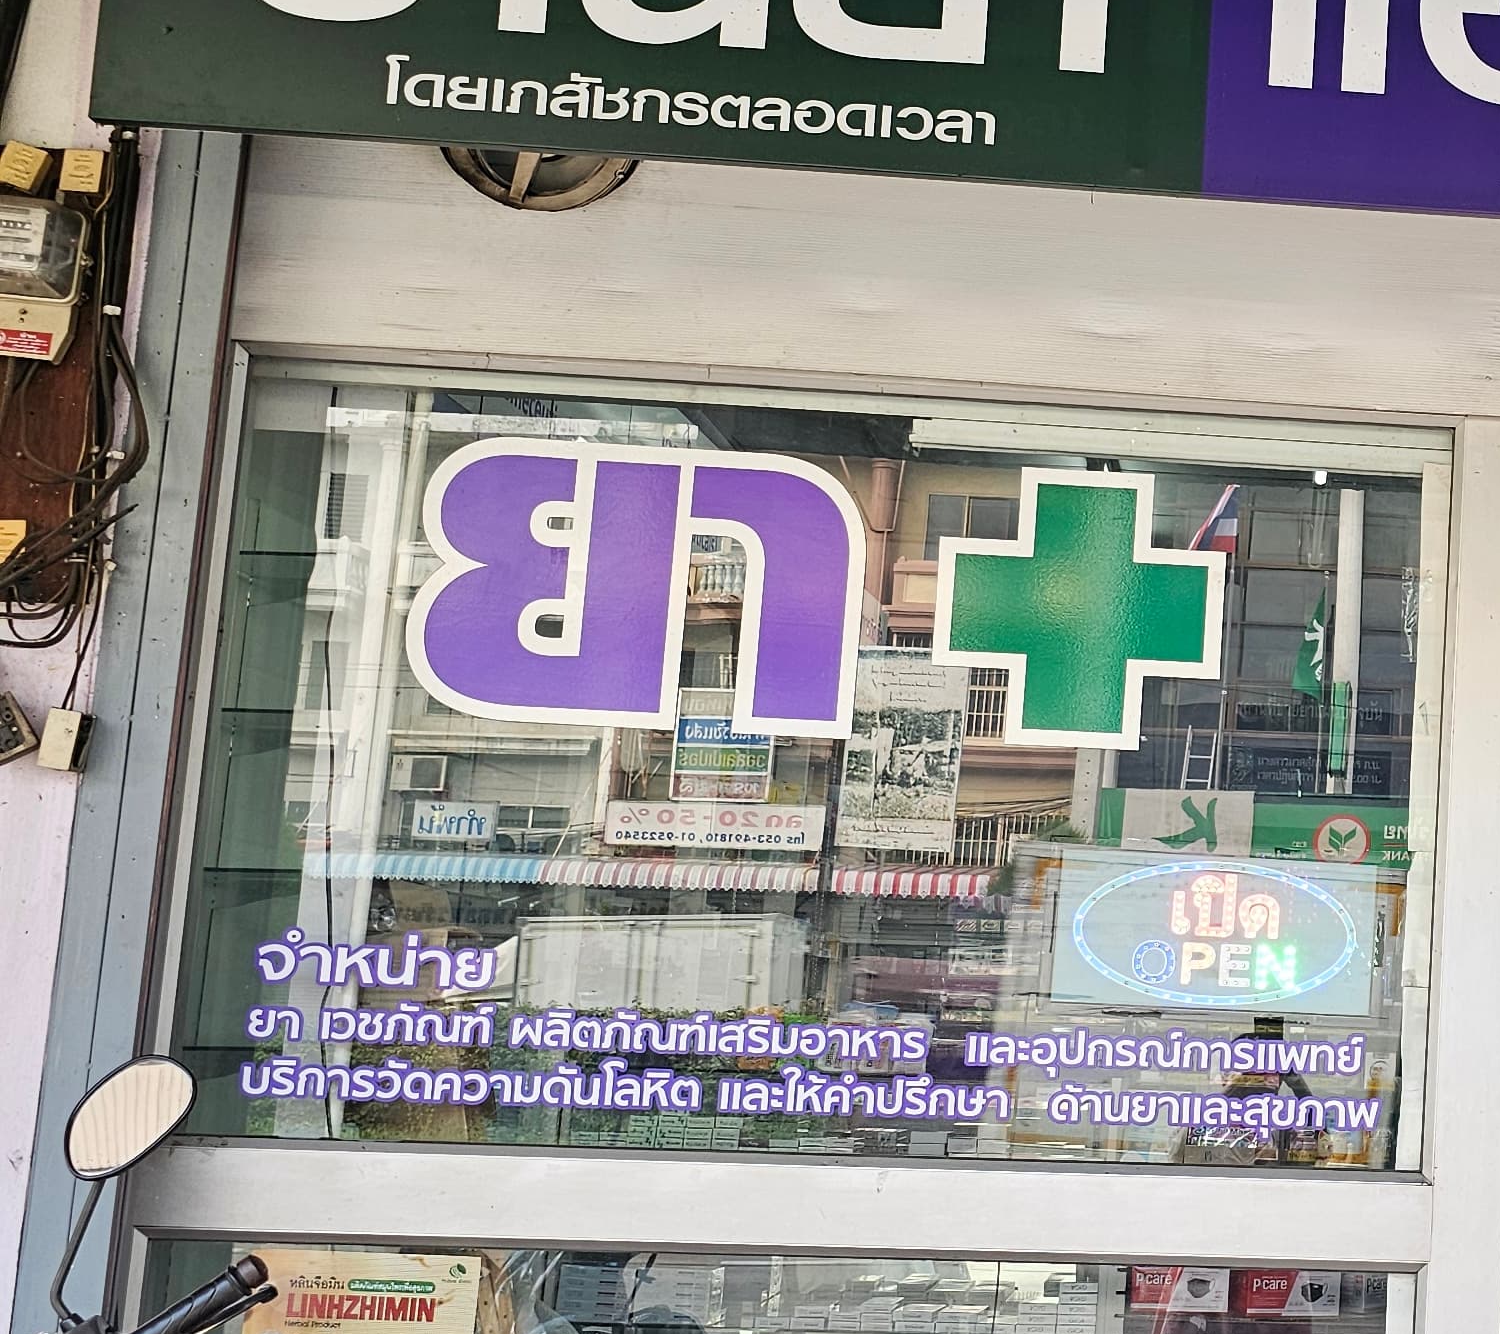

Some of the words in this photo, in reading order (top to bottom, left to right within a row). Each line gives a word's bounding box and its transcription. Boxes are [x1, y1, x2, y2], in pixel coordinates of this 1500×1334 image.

[385, 53, 997, 147] โดยเภสัชกรตลอดเวลา
[405, 436, 867, 739] ยา
[1169, 871, 1282, 941] เปิด
[256, 928, 496, 989] จำหน่าย
[1131, 938, 1299, 992] OPEN
[247, 1007, 301, 1040] ยา
[319, 1003, 496, 1047] เวชภัณฑ์
[509, 1008, 928, 1060] ผลิตภัณฑ์เสริมอาหาร
[965, 1027, 1366, 1079] และอุปกรณ์การแพทย์
[241, 1056, 700, 1110] บริการวัดความดันโลหิต
[718, 1067, 1010, 1119] และให้คำปรึกษา
[1049, 1087, 1379, 1138] ด้านยาและสุขภาพ
[286, 1293, 437, 1323] LINHZHIMIN
